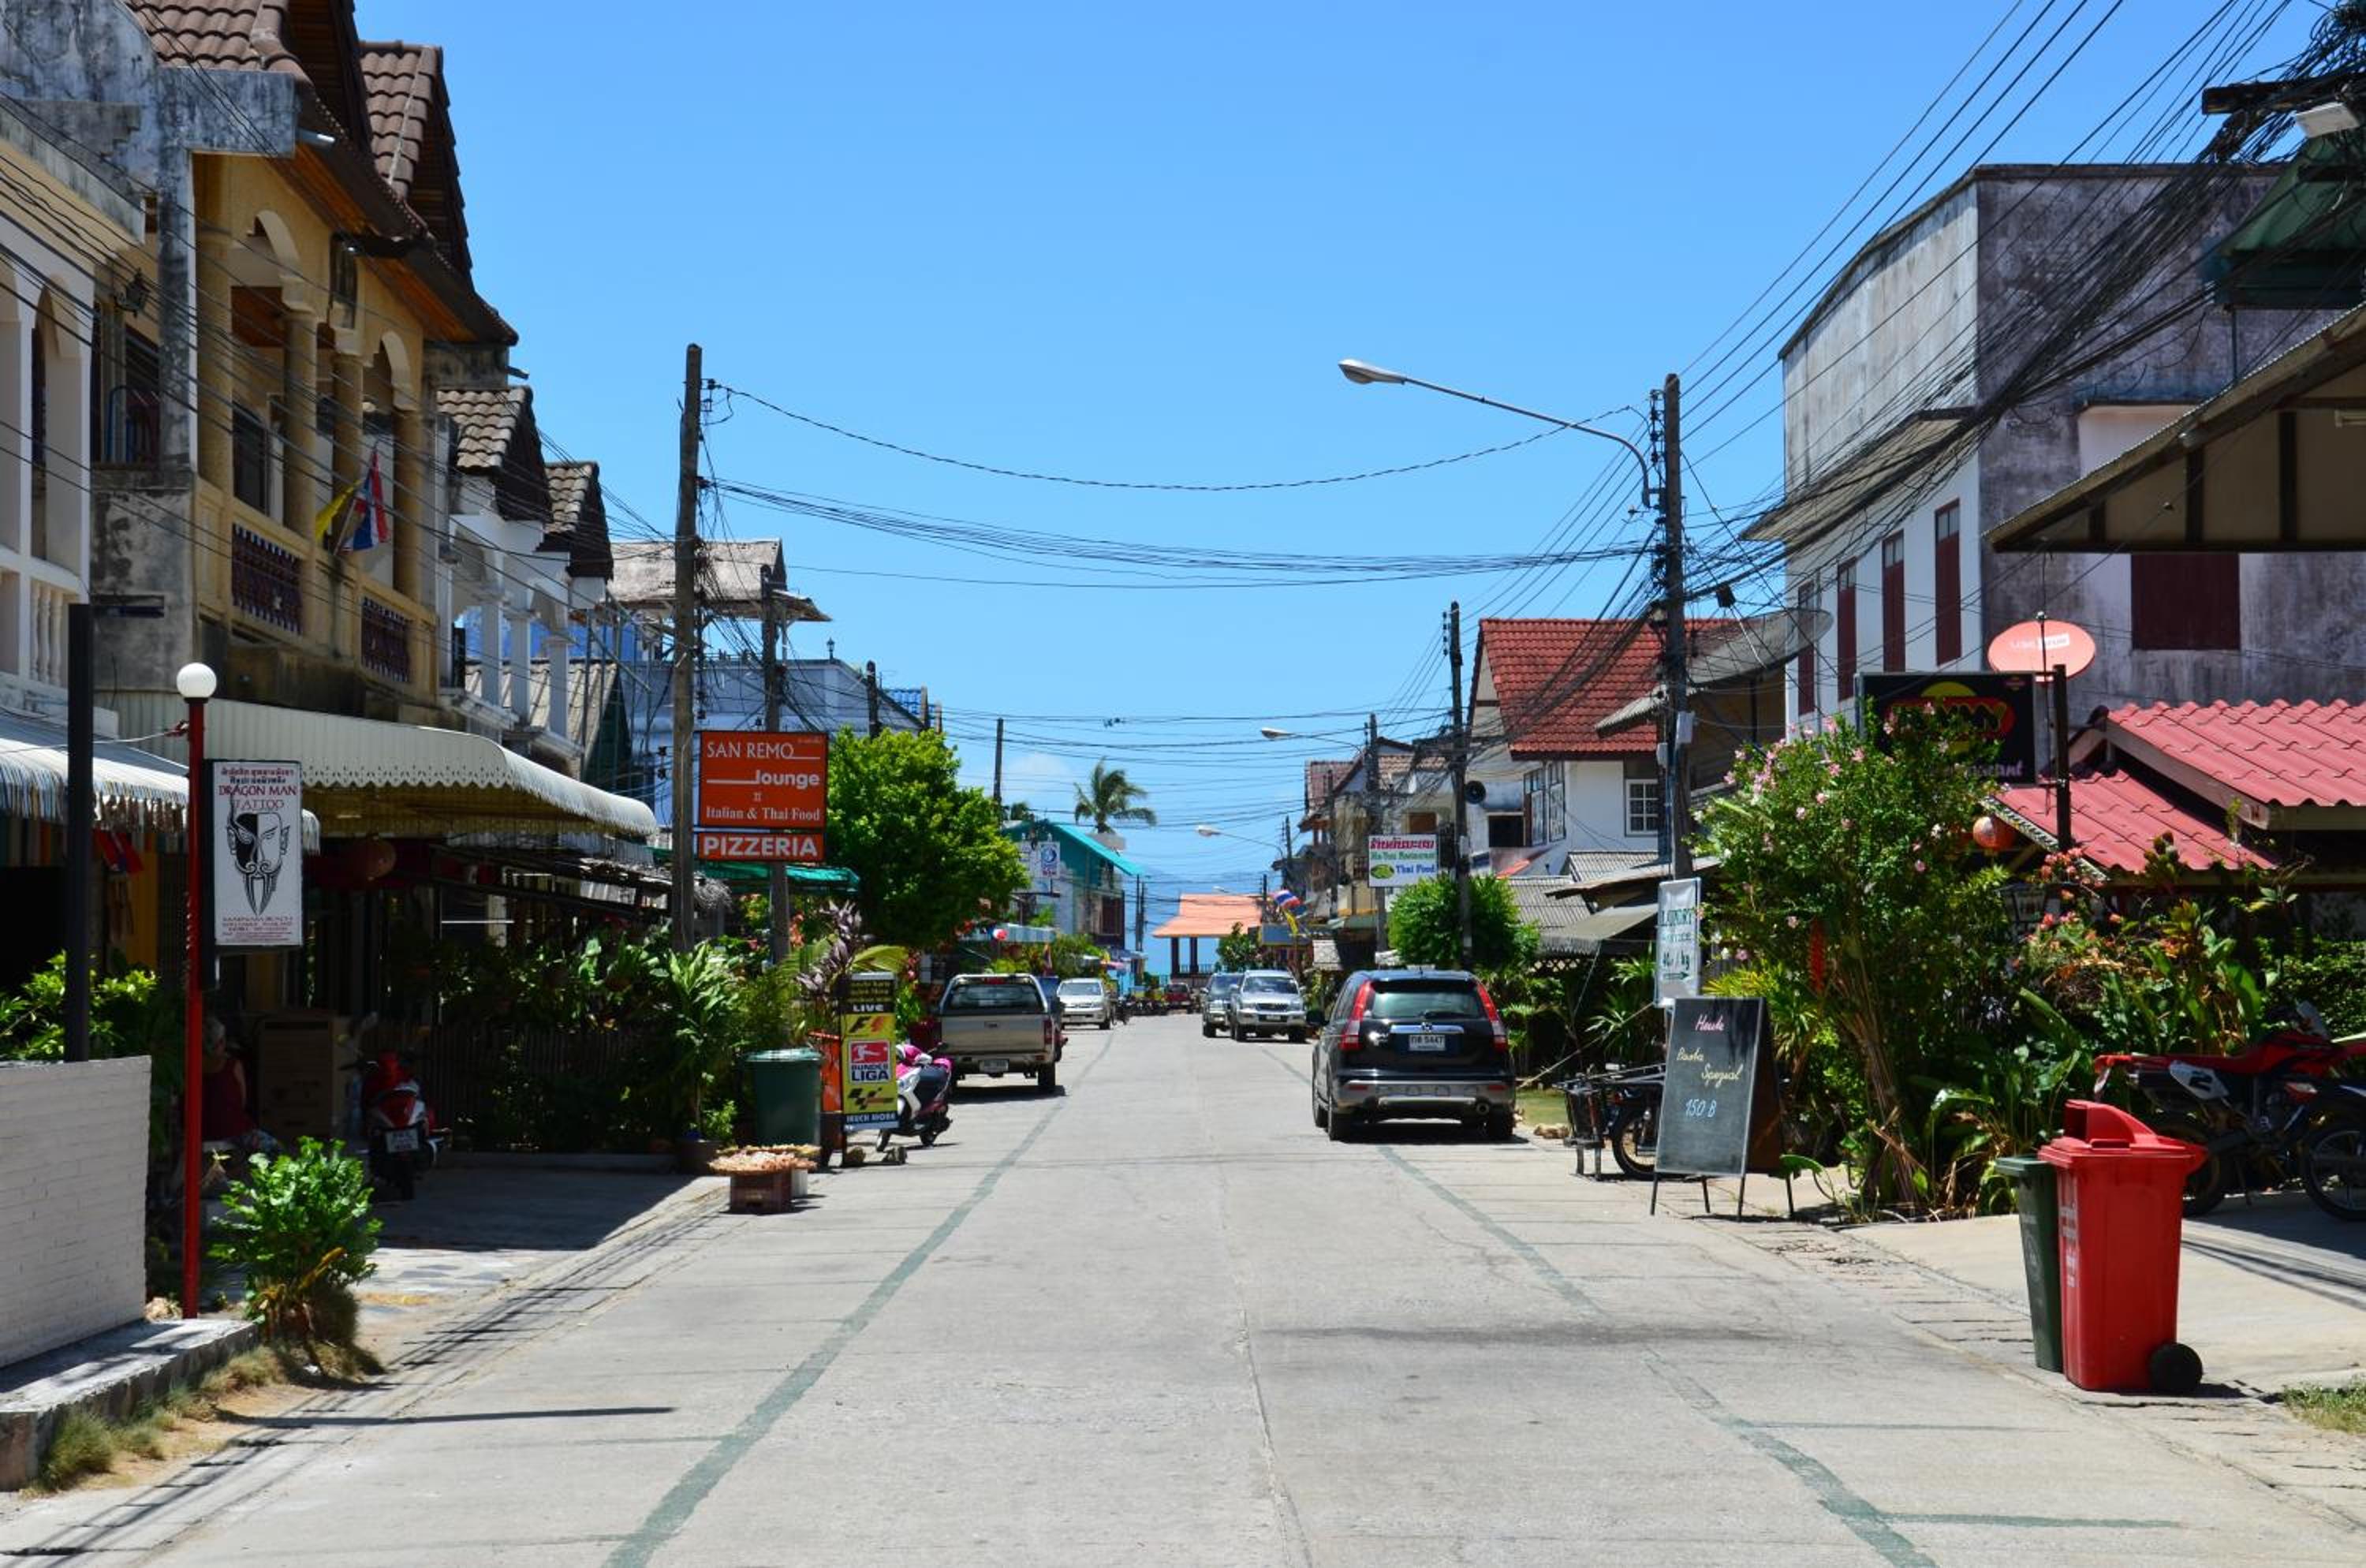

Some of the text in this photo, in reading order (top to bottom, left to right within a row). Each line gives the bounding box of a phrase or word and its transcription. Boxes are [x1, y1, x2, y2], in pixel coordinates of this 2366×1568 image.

[707, 741, 794, 759] SAN REMO
[756, 770, 820, 790] lounge
[218, 785, 297, 796] DRAGON MAN
[234, 799, 285, 808] TATTOO
[706, 806, 820, 821] Italian & Thai Food
[703, 836, 818, 857] PIZZERIA
[1396, 864, 1435, 873] Thai Food
[1696, 1014, 1725, 1032] Heute
[852, 1071, 889, 1081] LIGA
[1701, 1062, 1744, 1088] Spezial
[1686, 1099, 1706, 1118] 150
